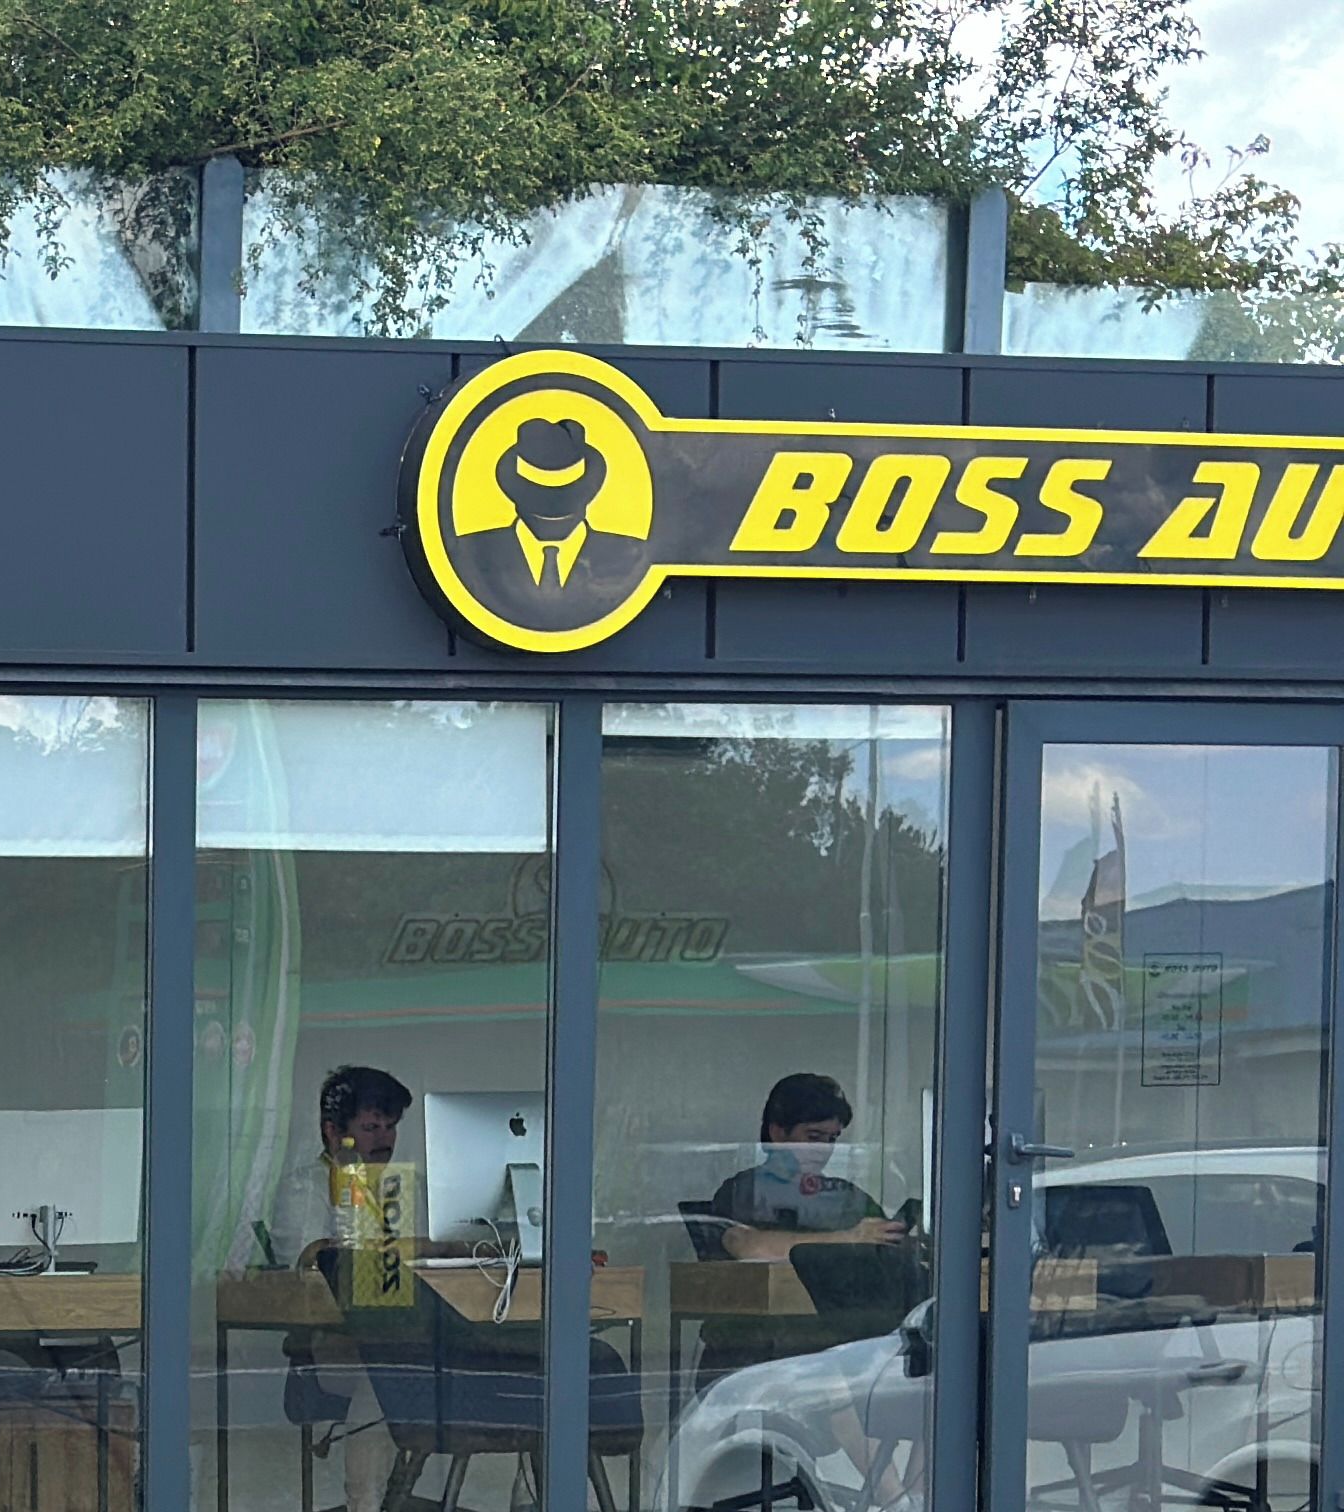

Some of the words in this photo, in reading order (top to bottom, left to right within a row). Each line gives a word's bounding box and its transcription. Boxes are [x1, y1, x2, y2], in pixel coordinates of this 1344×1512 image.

[730, 451, 1112, 556] BOSS
[1136, 460, 1344, 561] AU
[387, 918, 548, 963] BOSS
[598, 918, 729, 962] UTO
